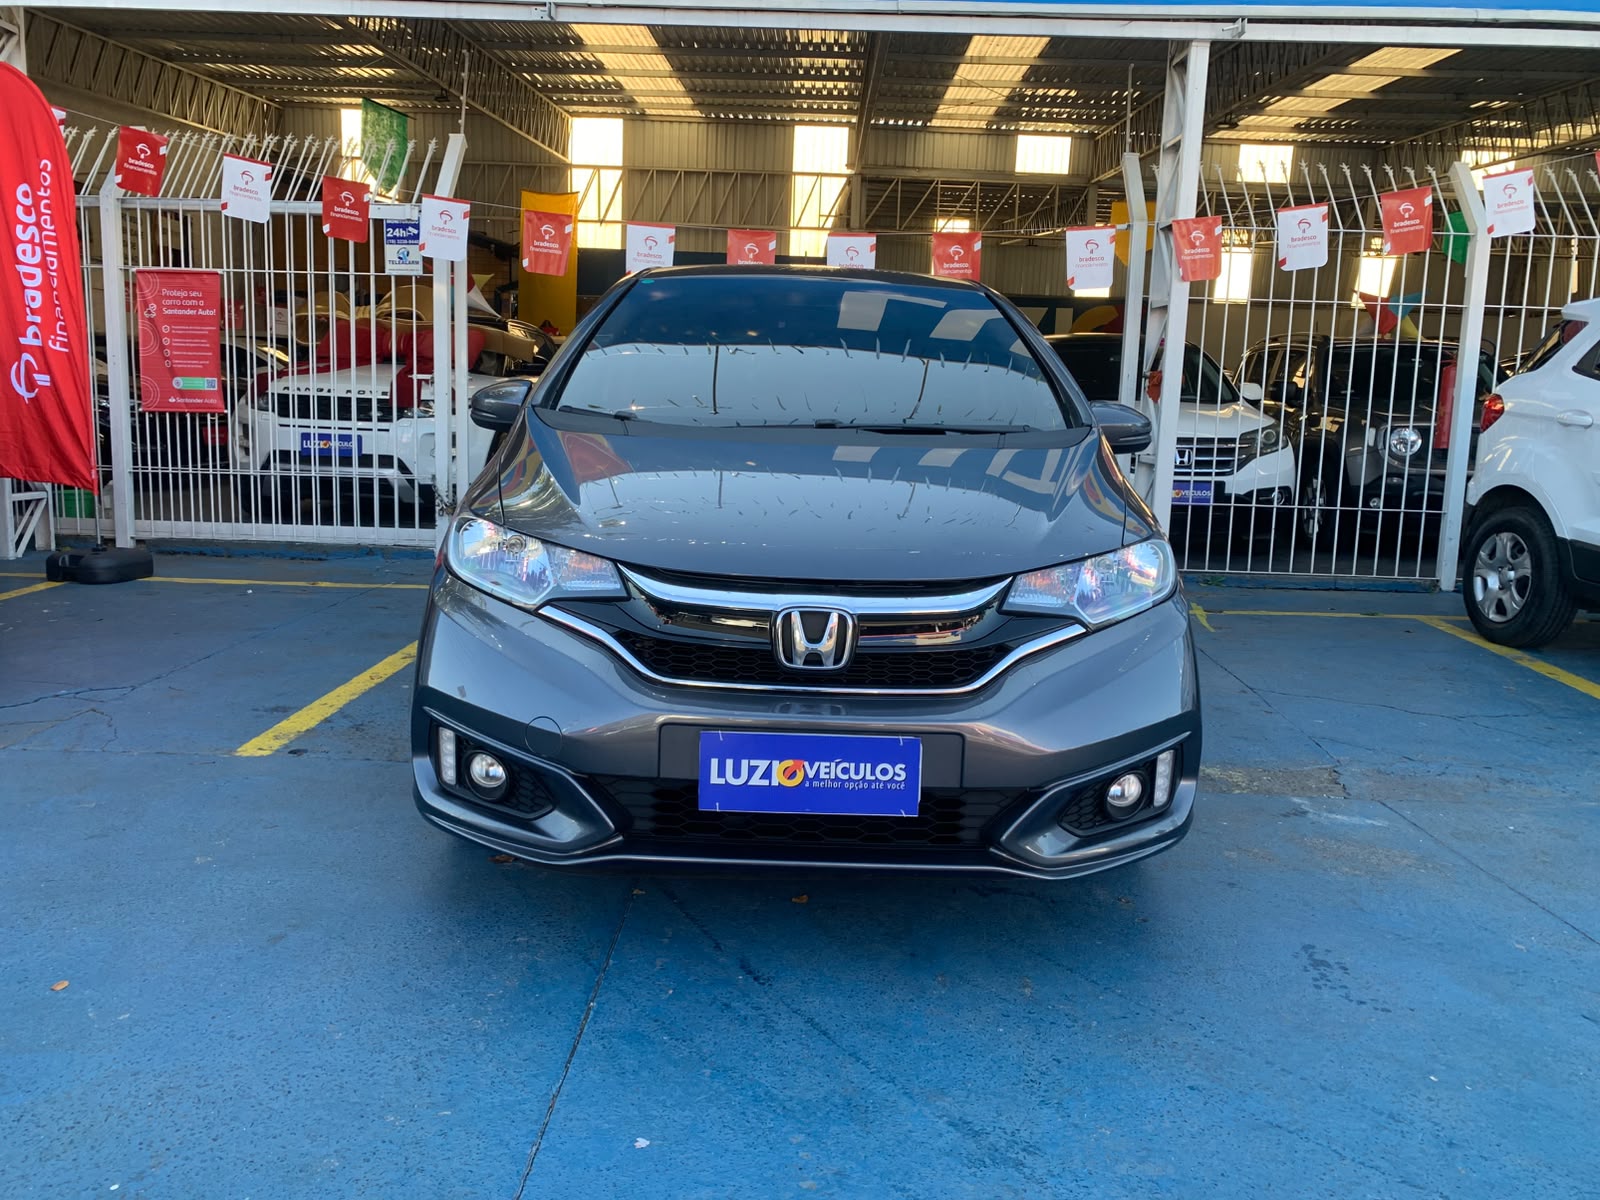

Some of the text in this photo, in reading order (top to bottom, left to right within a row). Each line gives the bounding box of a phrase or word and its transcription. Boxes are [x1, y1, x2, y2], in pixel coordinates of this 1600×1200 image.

[128, 156, 155, 169] bradesco
[123, 162, 157, 176] financiamentos
[233, 184, 259, 196] bradesco
[1497, 199, 1525, 209] bradesco
[334, 205, 360, 216] bradesco
[1393, 218, 1420, 228] bradesco
[386, 227, 406, 238] 24h
[431, 224, 457, 234] bradesco
[533, 240, 559, 248] bradesco
[1290, 234, 1317, 243] bradesco
[37, 158, 69, 352] financiamentos
[636, 251, 663, 259] bradesco
[15, 182, 43, 347] bradesco
[161, 288, 188, 298] Proteja
[162, 307, 216, 316] Santander Auto!
[804, 758, 907, 782] VEÍCULOS
[804, 779, 906, 791] a melhor opção até você
